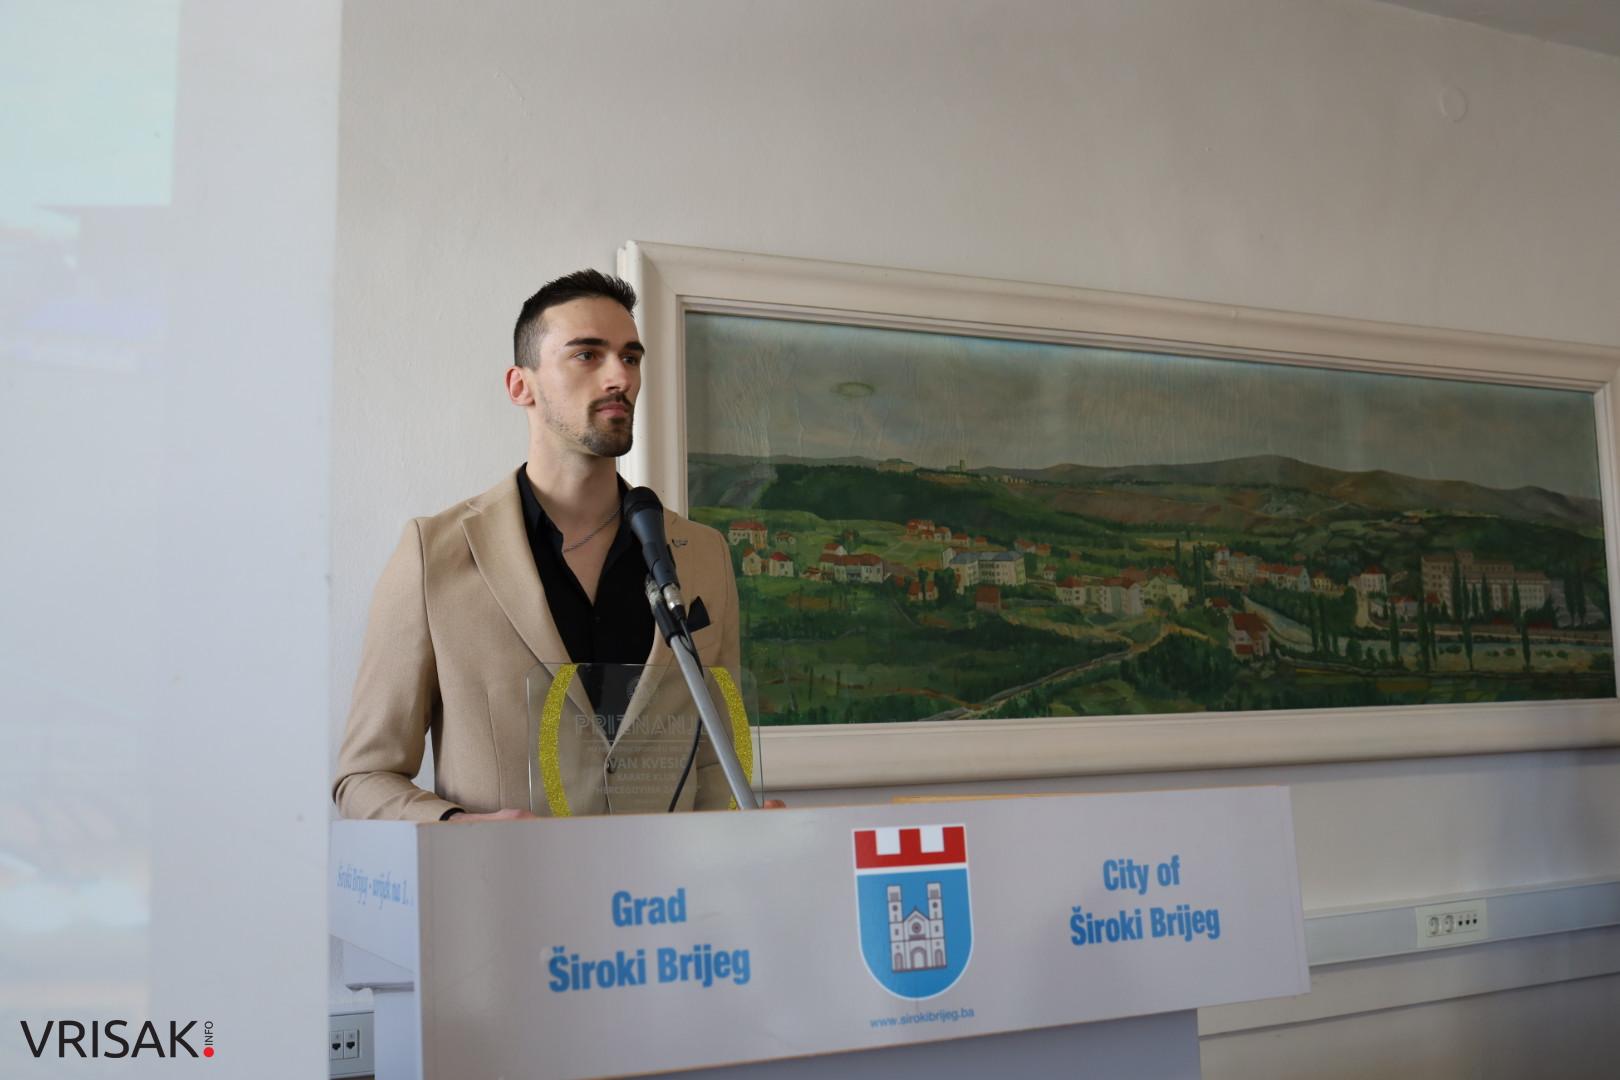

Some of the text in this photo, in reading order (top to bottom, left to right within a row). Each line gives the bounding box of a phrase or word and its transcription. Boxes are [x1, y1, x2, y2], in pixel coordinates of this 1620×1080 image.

[1102, 854, 1181, 896] City of
[612, 886, 688, 928] Grad
[1069, 903, 1222, 947] Široki Brijeg
[548, 943, 752, 993] Široki Brijeg
[869, 1007, 976, 1029] www.sirokibrijeg.ba
